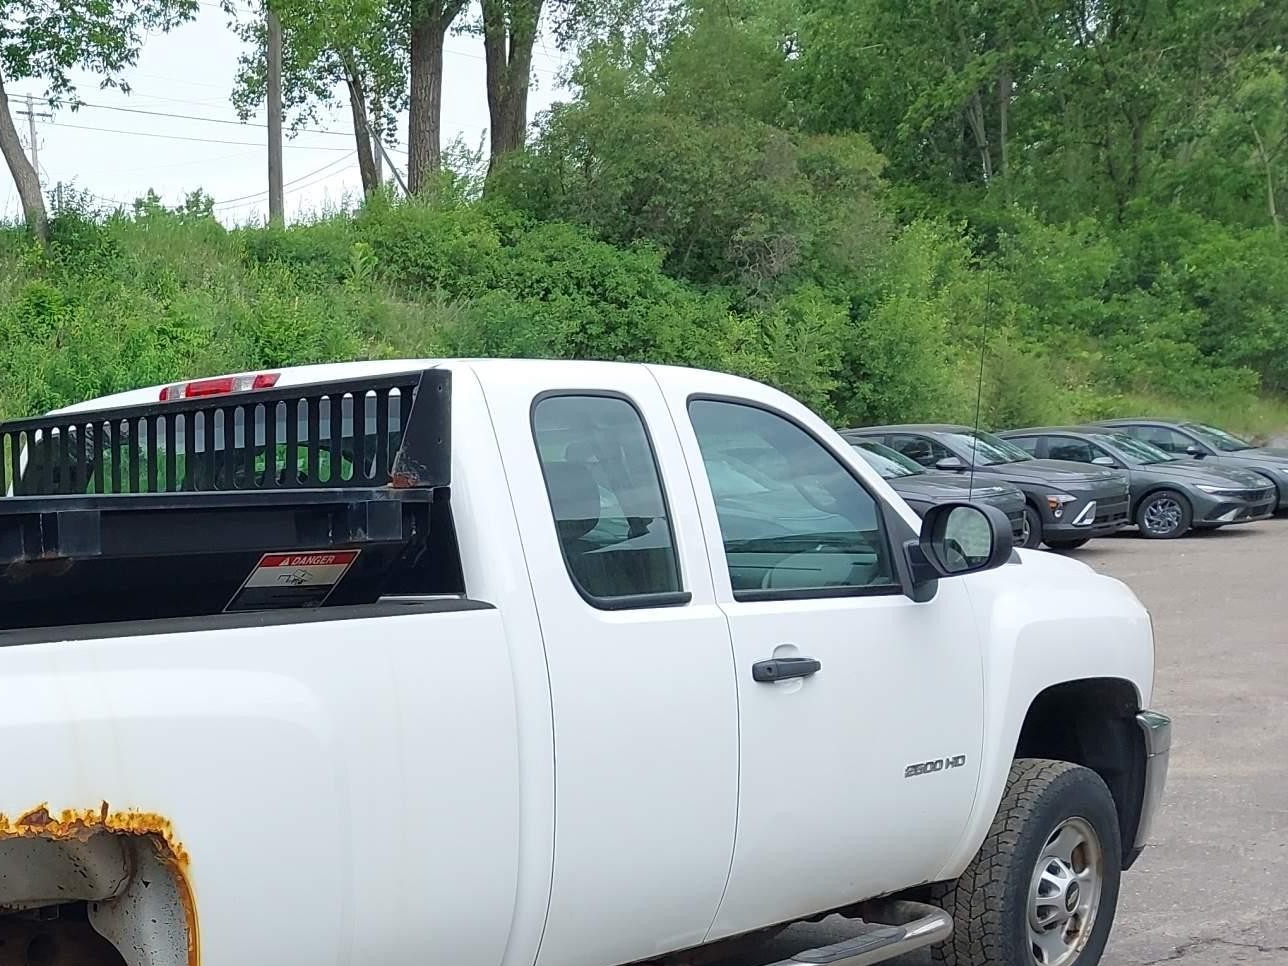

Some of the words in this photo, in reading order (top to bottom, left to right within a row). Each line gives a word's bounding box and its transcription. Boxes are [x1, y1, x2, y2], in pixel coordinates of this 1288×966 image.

[291, 555, 336, 566] DANGER
[904, 759, 944, 778] 2500
[944, 754, 966, 769] HD
